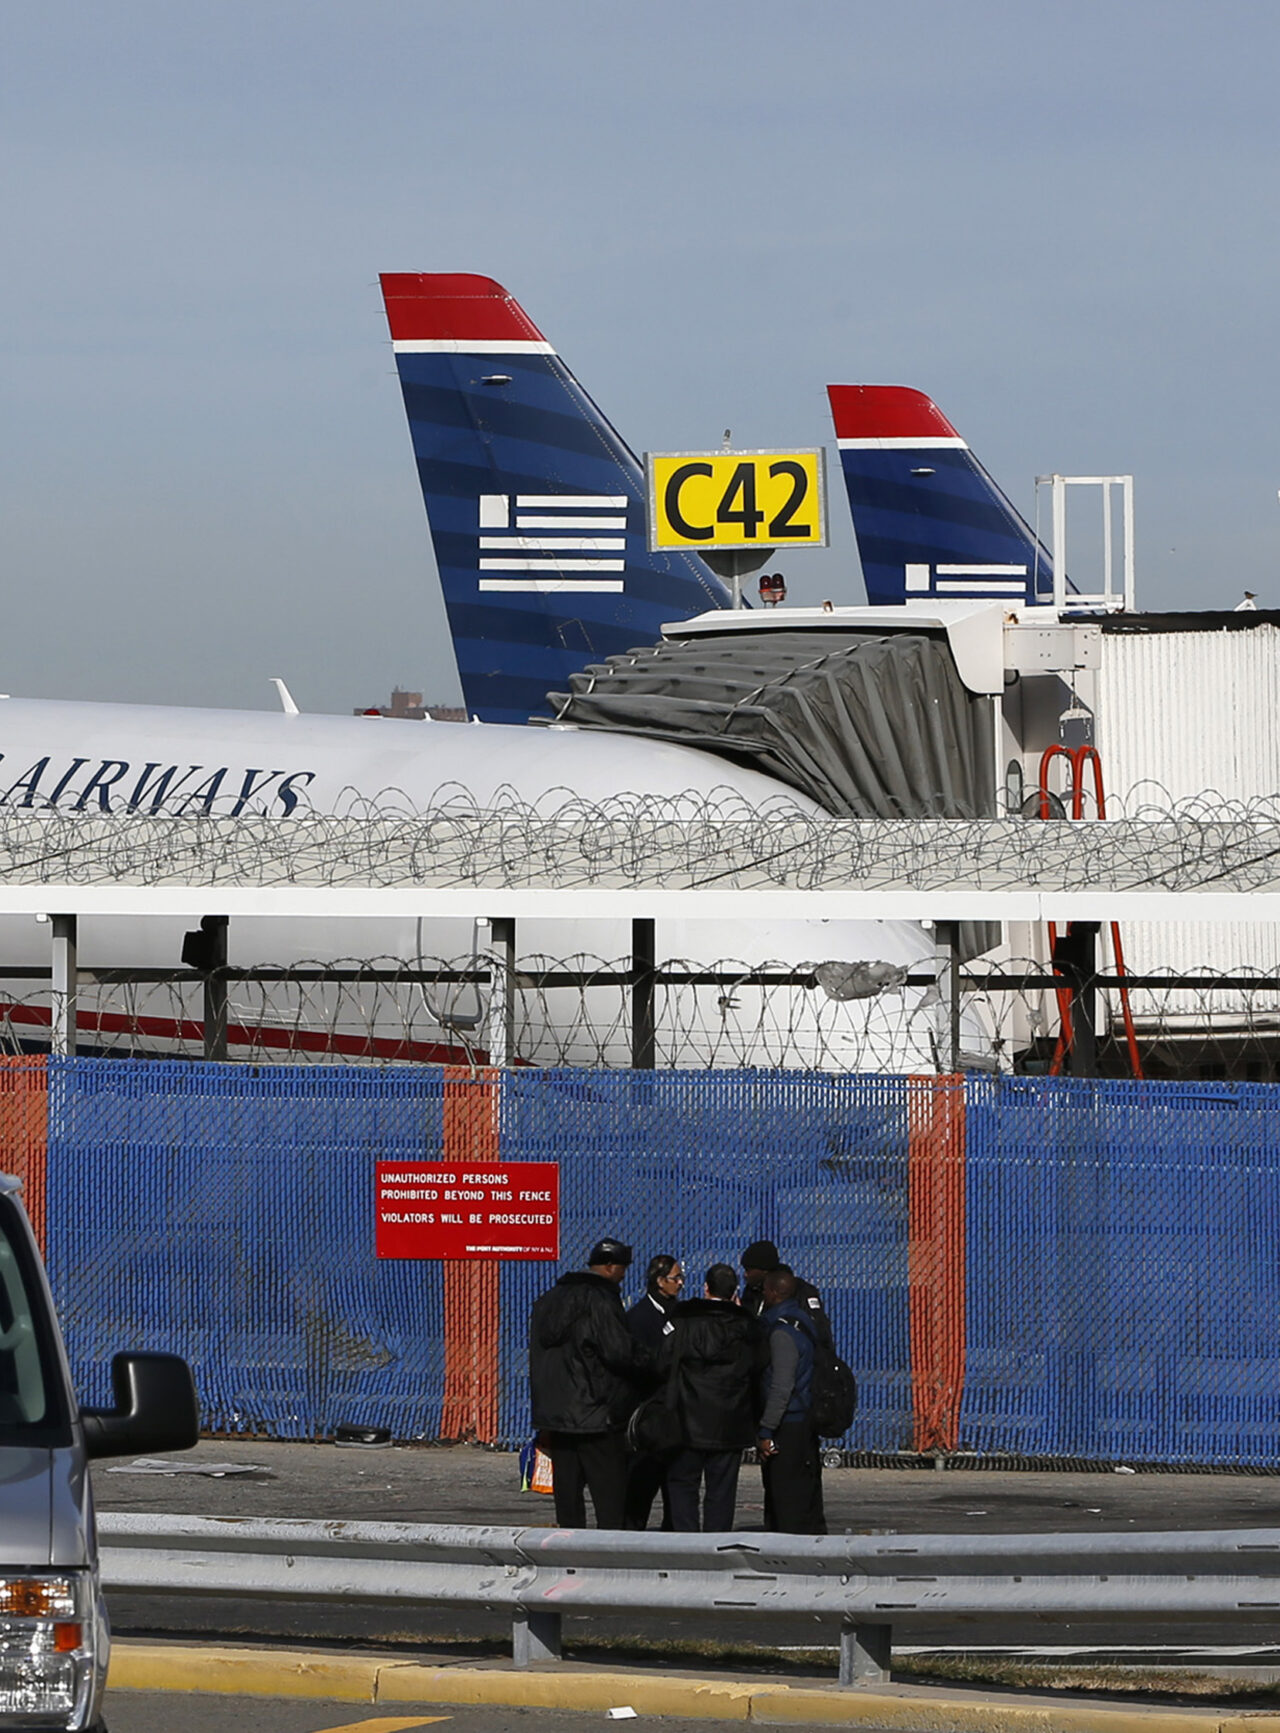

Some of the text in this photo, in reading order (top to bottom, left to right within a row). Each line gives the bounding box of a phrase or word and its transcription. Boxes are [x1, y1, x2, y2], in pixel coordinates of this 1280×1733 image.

[664, 460, 812, 541] C42
[381, 1173, 509, 1185] UNAUTHORIZED PERSONS
[381, 1189, 551, 1201] PROHIBITED BEYOND THIS FENCE
[381, 1213, 553, 1225] VIOLATORS WILL BE PROSECUTED
